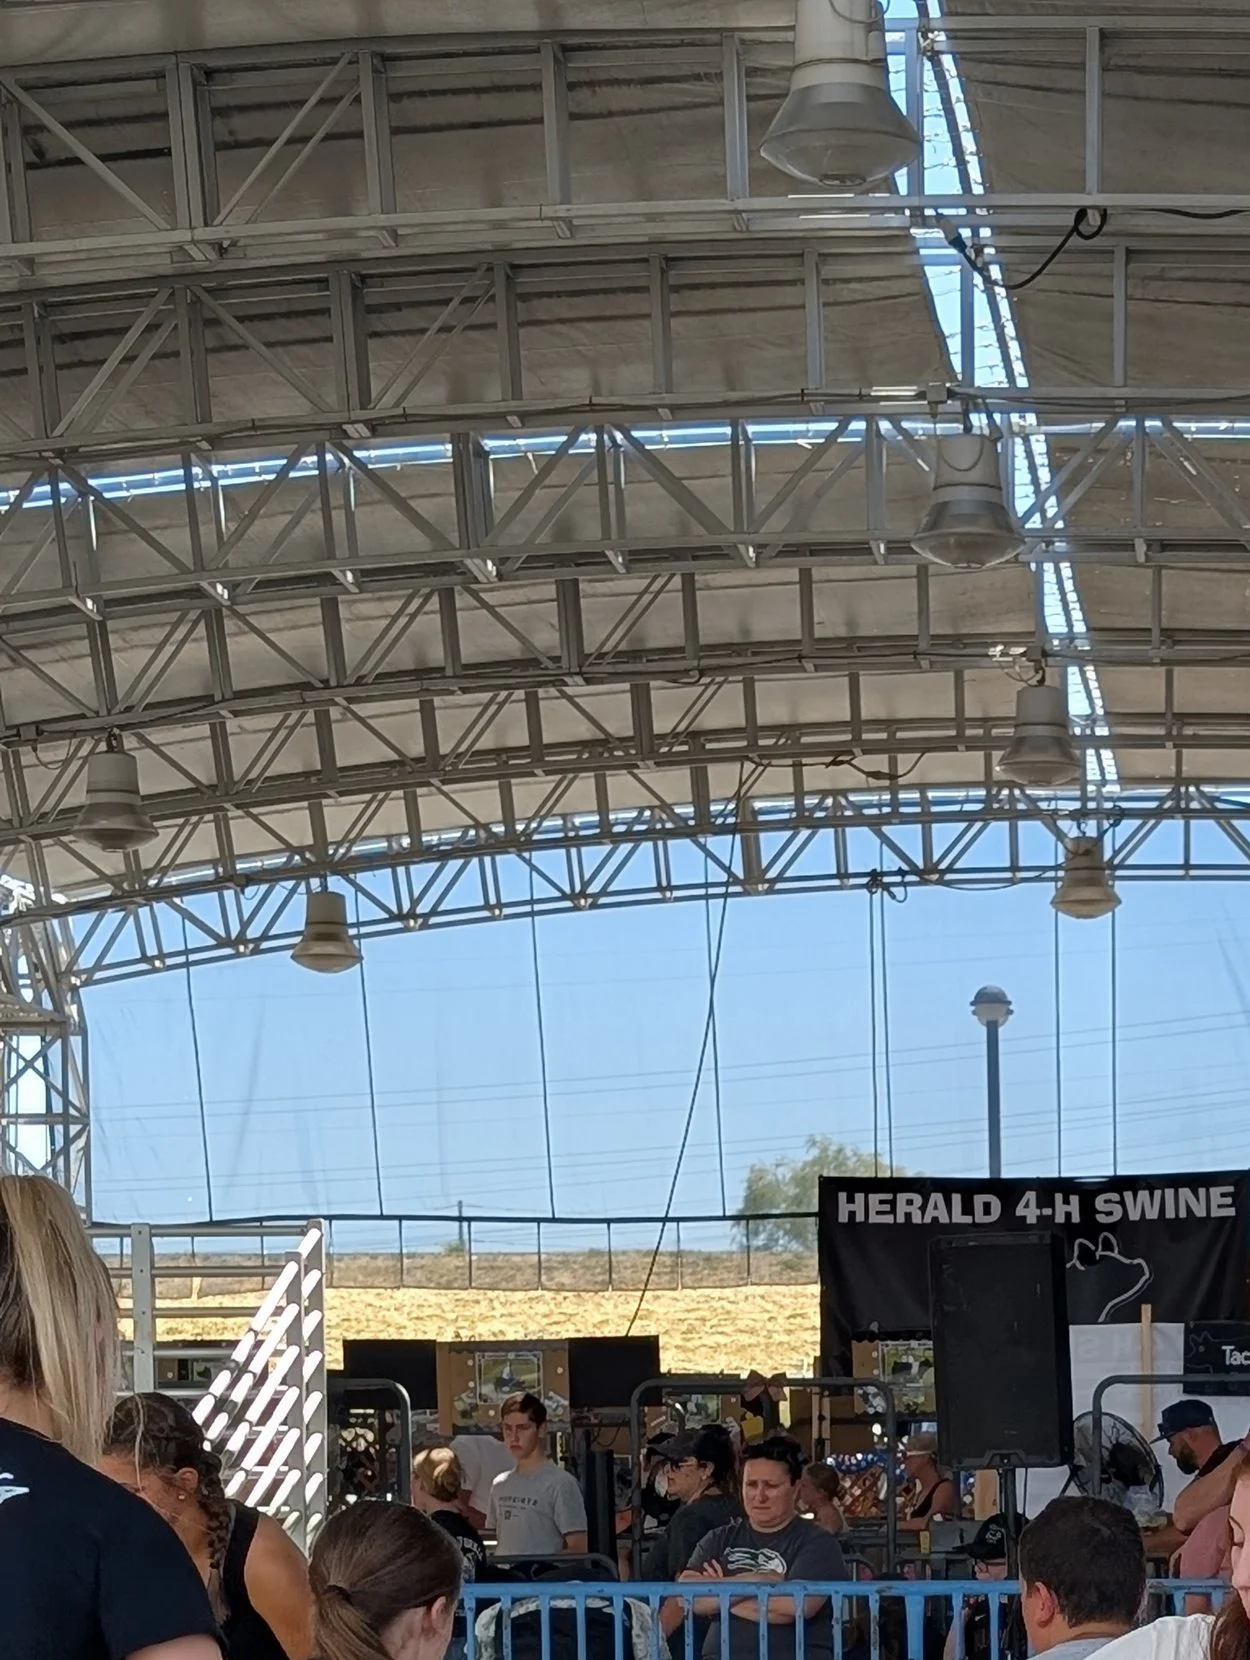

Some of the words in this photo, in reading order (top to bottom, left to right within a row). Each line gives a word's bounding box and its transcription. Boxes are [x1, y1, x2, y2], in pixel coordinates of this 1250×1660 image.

[837, 1190, 1001, 1224] HERALD
[1014, 1190, 1080, 1224] 4-H
[1095, 1186, 1236, 1223] SWINE
